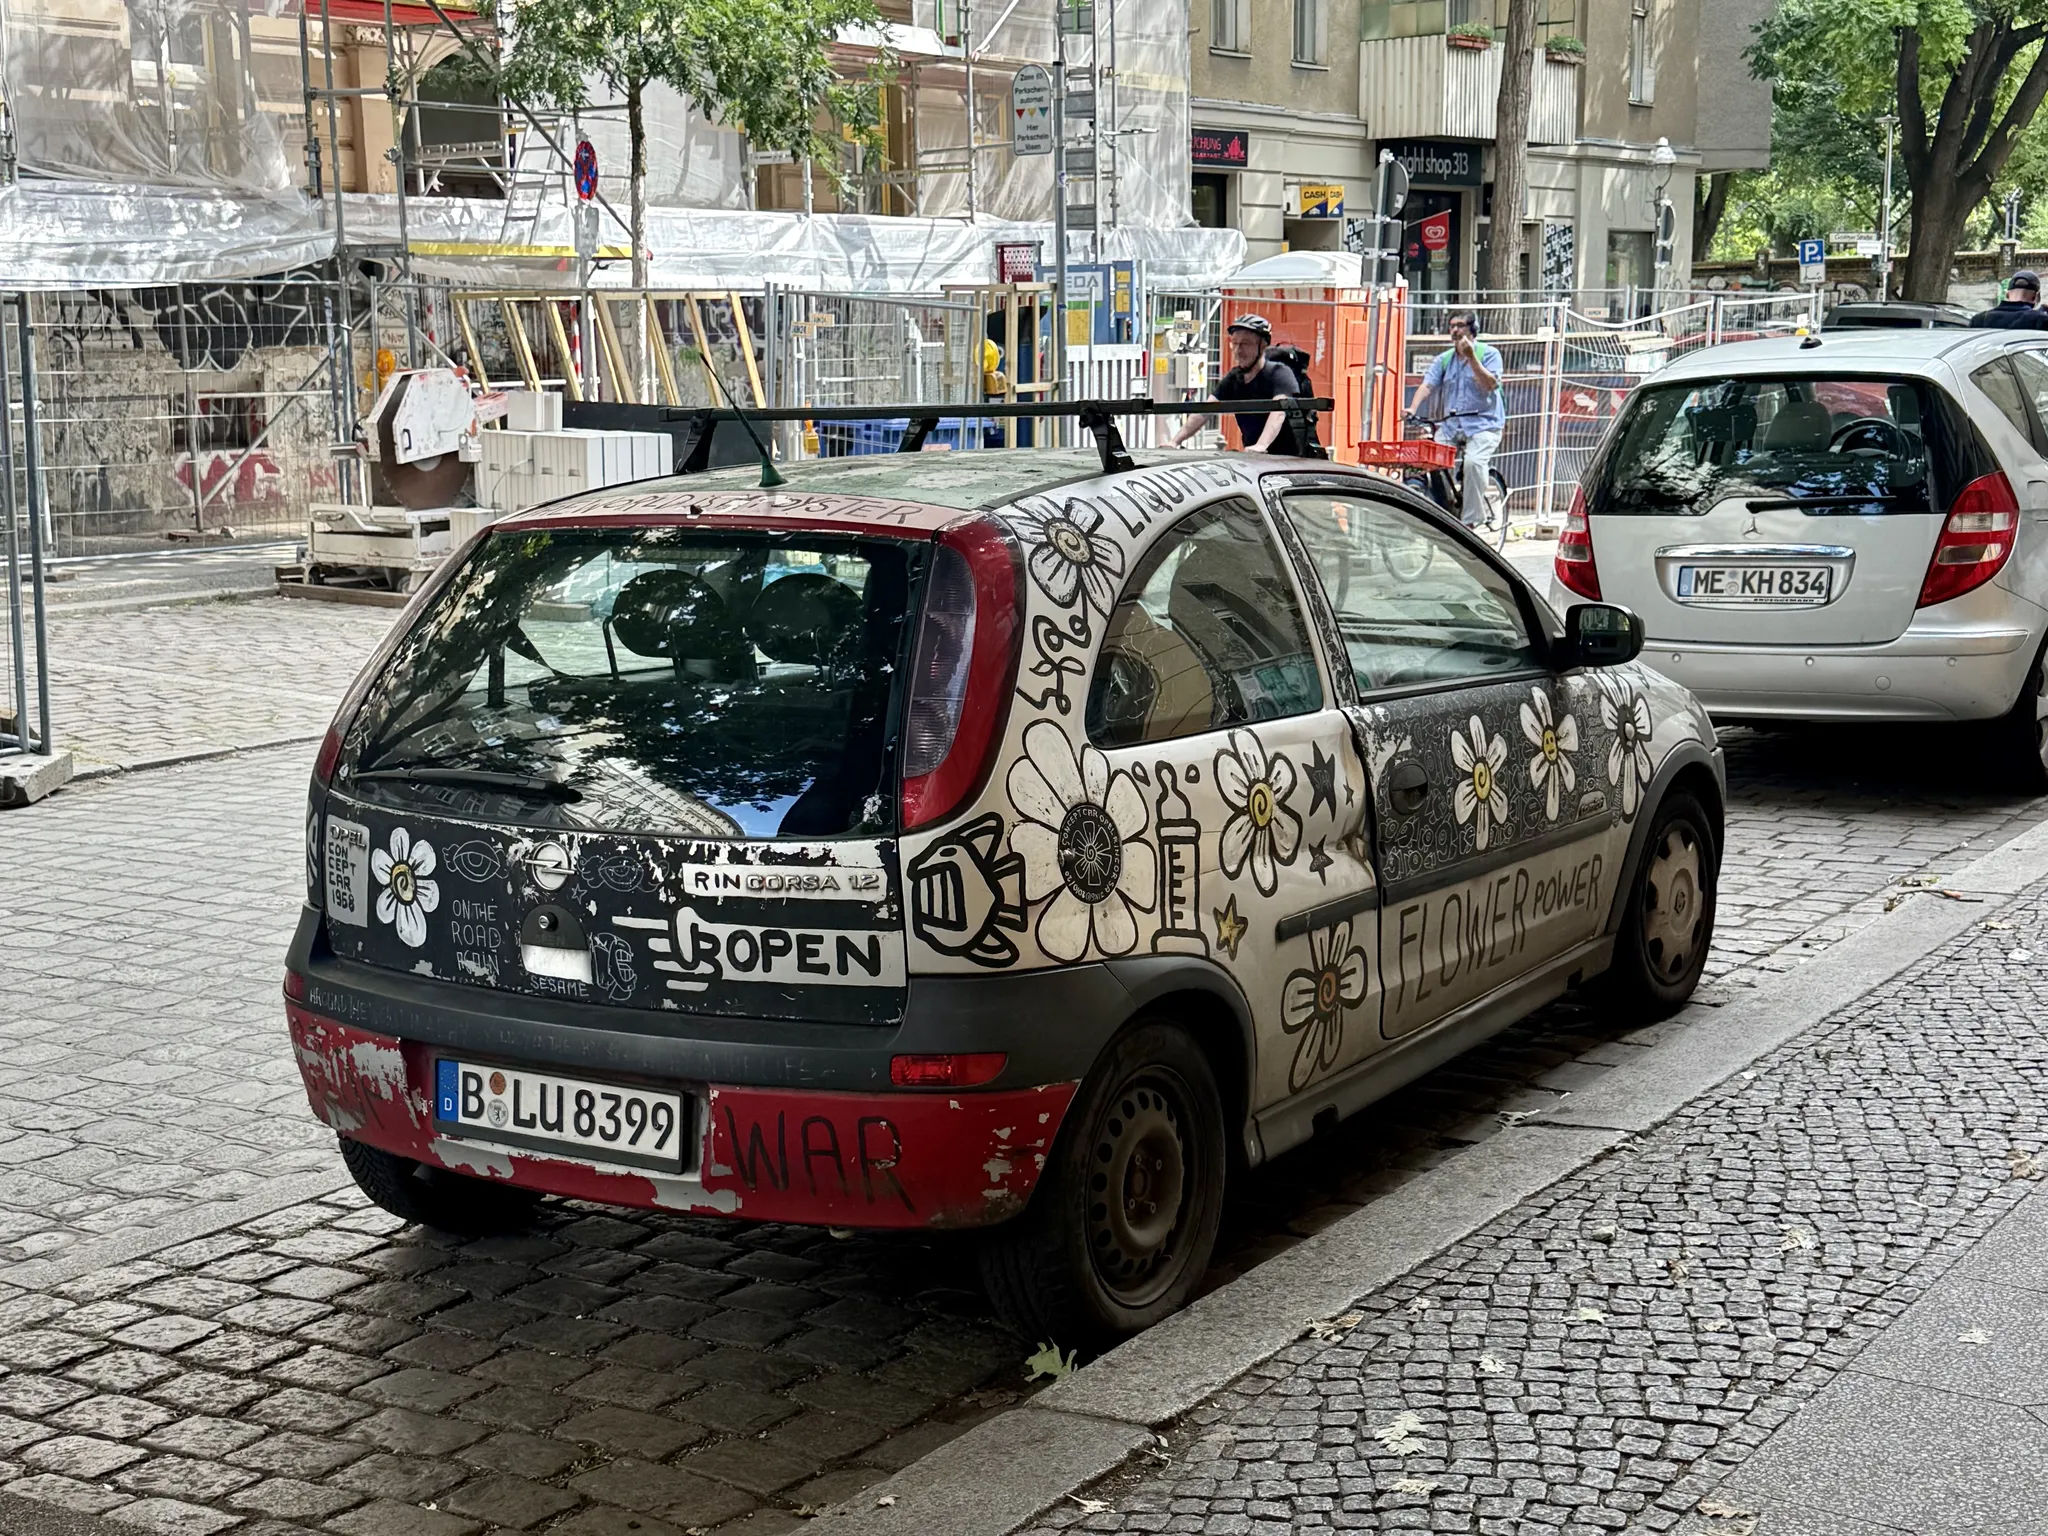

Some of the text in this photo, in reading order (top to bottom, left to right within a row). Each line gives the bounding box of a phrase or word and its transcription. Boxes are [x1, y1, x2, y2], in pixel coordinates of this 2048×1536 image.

[1425, 147, 1452, 180] shop
[1452, 152, 1469, 175] 313
[1303, 190, 1326, 199] CASH
[1330, 191, 1343, 199] CASH
[1804, 243, 1819, 262] P
[1048, 275, 1099, 288] EDA
[1096, 461, 1253, 539] LIQUITEX
[1694, 571, 1826, 595] ME KH 834
[330, 824, 368, 851] OPEL
[328, 842, 349, 860] CON
[328, 857, 356, 876] CEPT
[328, 872, 352, 893] CAR
[452, 900, 498, 922] ON THE
[451, 921, 501, 949] ROAD
[1396, 854, 1603, 1014] FLOWER POWER
[530, 976, 591, 998] SESAME
[443, 1097, 453, 1111] D
[461, 1070, 674, 1150] B LU 8399
[724, 1104, 918, 1215] WAR
